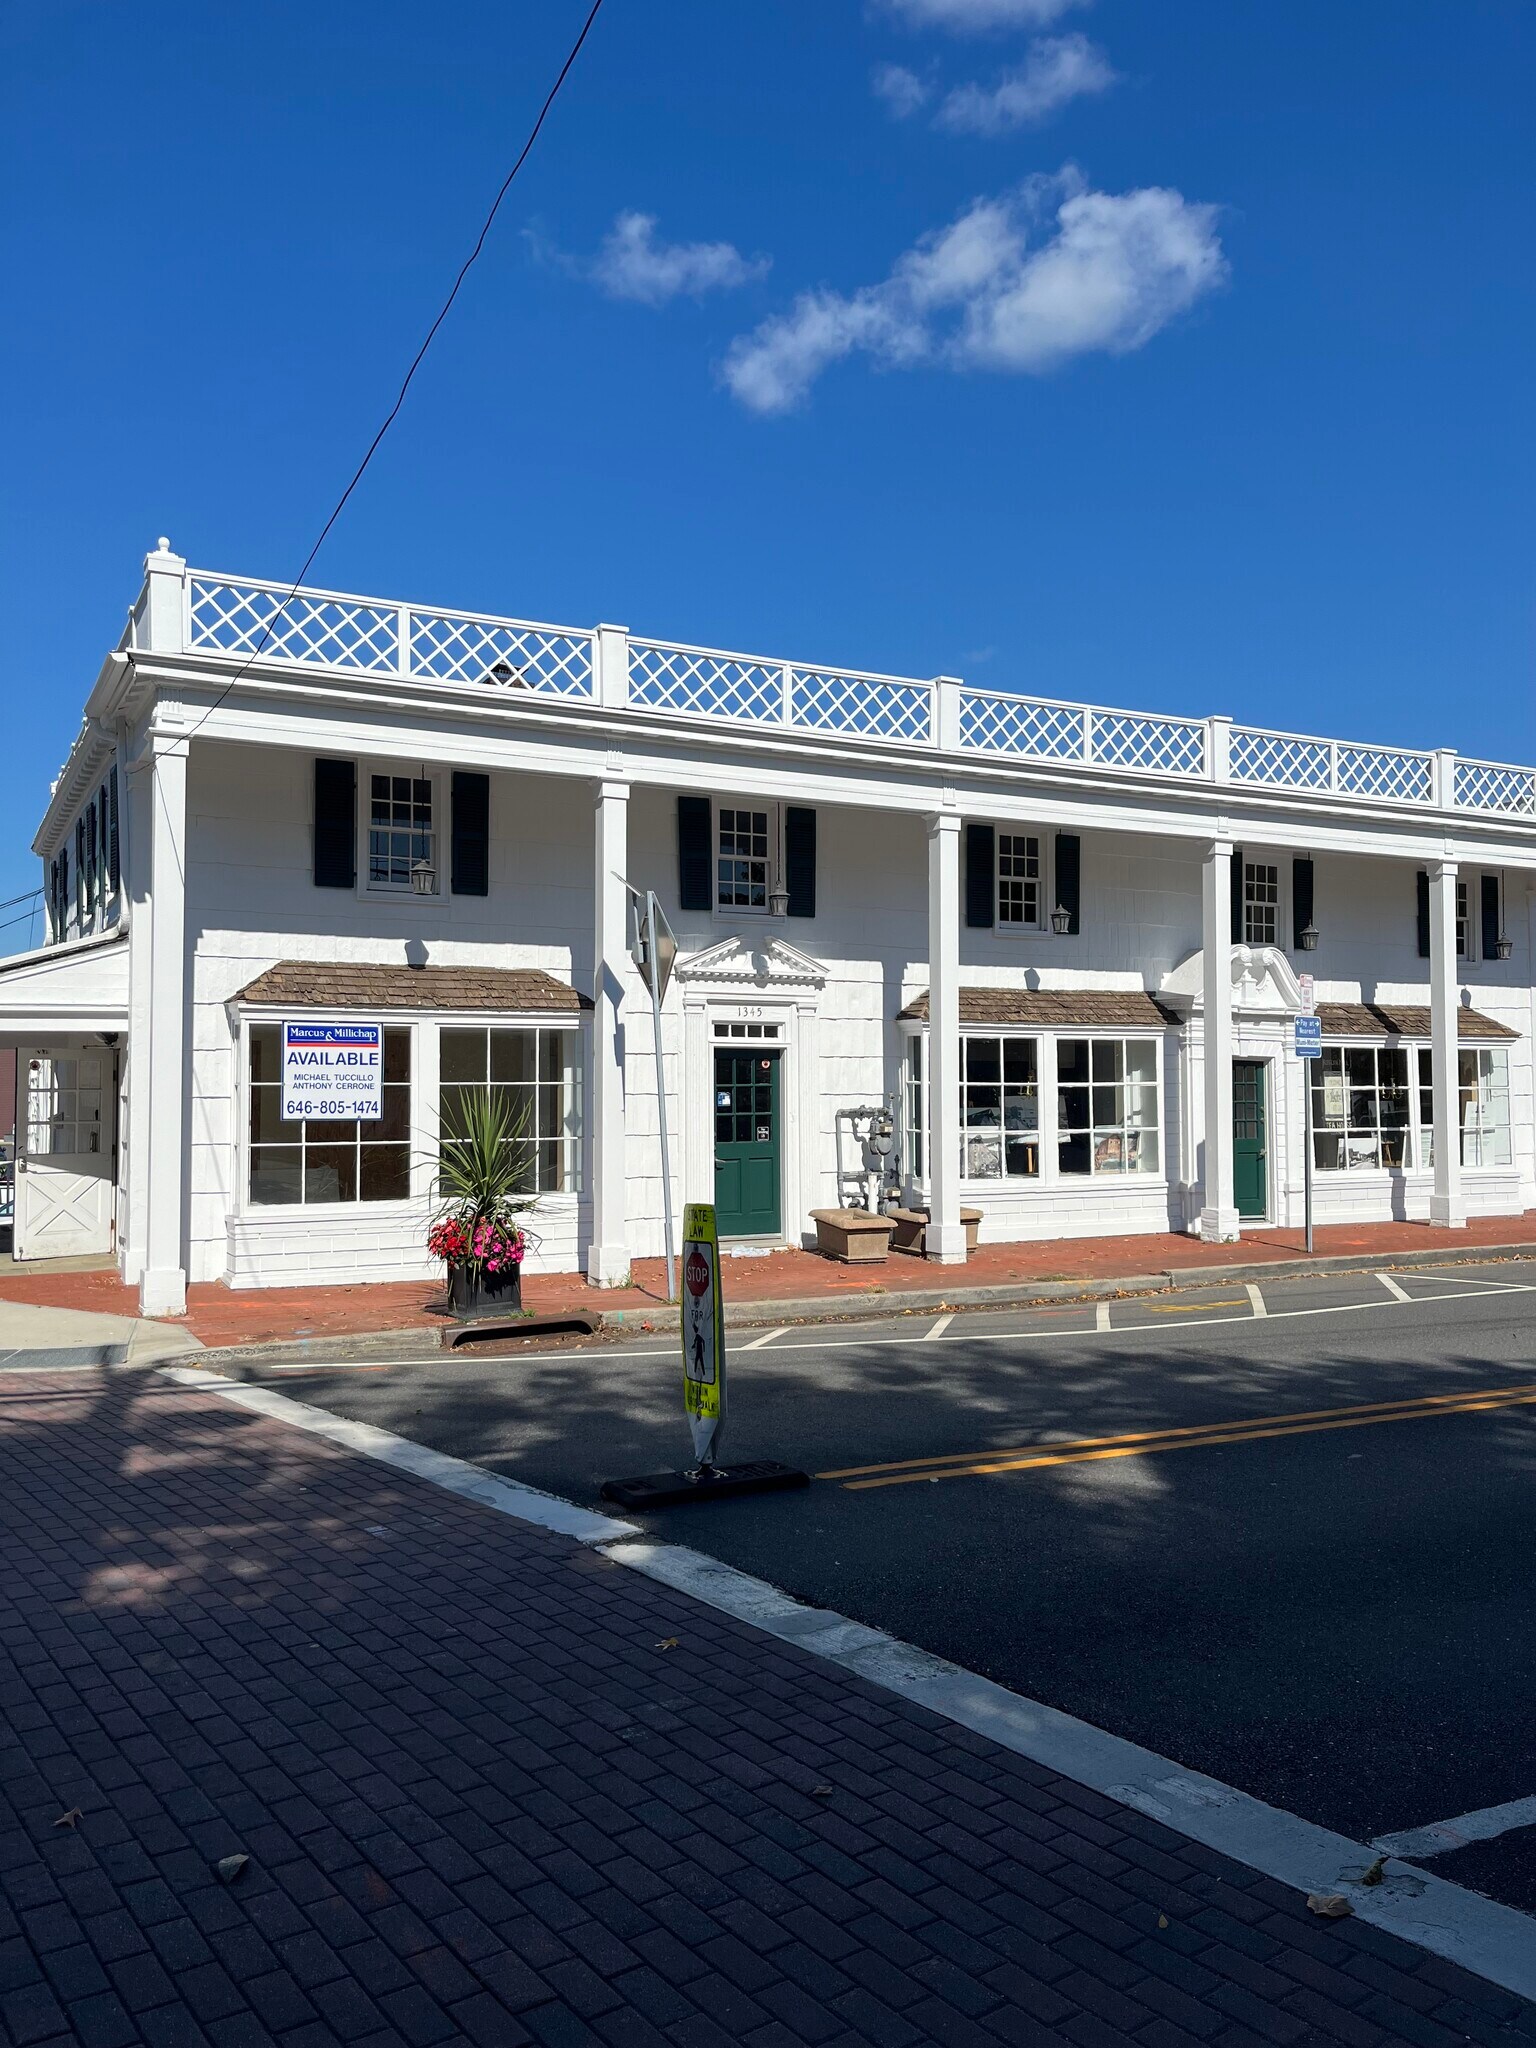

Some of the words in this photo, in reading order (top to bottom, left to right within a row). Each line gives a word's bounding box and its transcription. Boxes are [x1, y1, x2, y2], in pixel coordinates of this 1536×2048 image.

[737, 1006, 763, 1017] 1345
[290, 1027, 325, 1037] Marcus
[325, 1031, 336, 1042] &
[334, 1028, 377, 1042] Millichap
[287, 1051, 379, 1066] AVAILABLE
[293, 1073, 331, 1081] MICHAEL
[333, 1073, 374, 1082] TUCCILLO
[292, 1082, 333, 1090] ANTHONY
[335, 1082, 375, 1090] CERRONE
[287, 1100, 379, 1114] 646-805-1474
[688, 1208, 708, 1223] STATE
[689, 1225, 705, 1238] LAW
[687, 1265, 708, 1283] STOP
[691, 1309, 704, 1320] FOR
